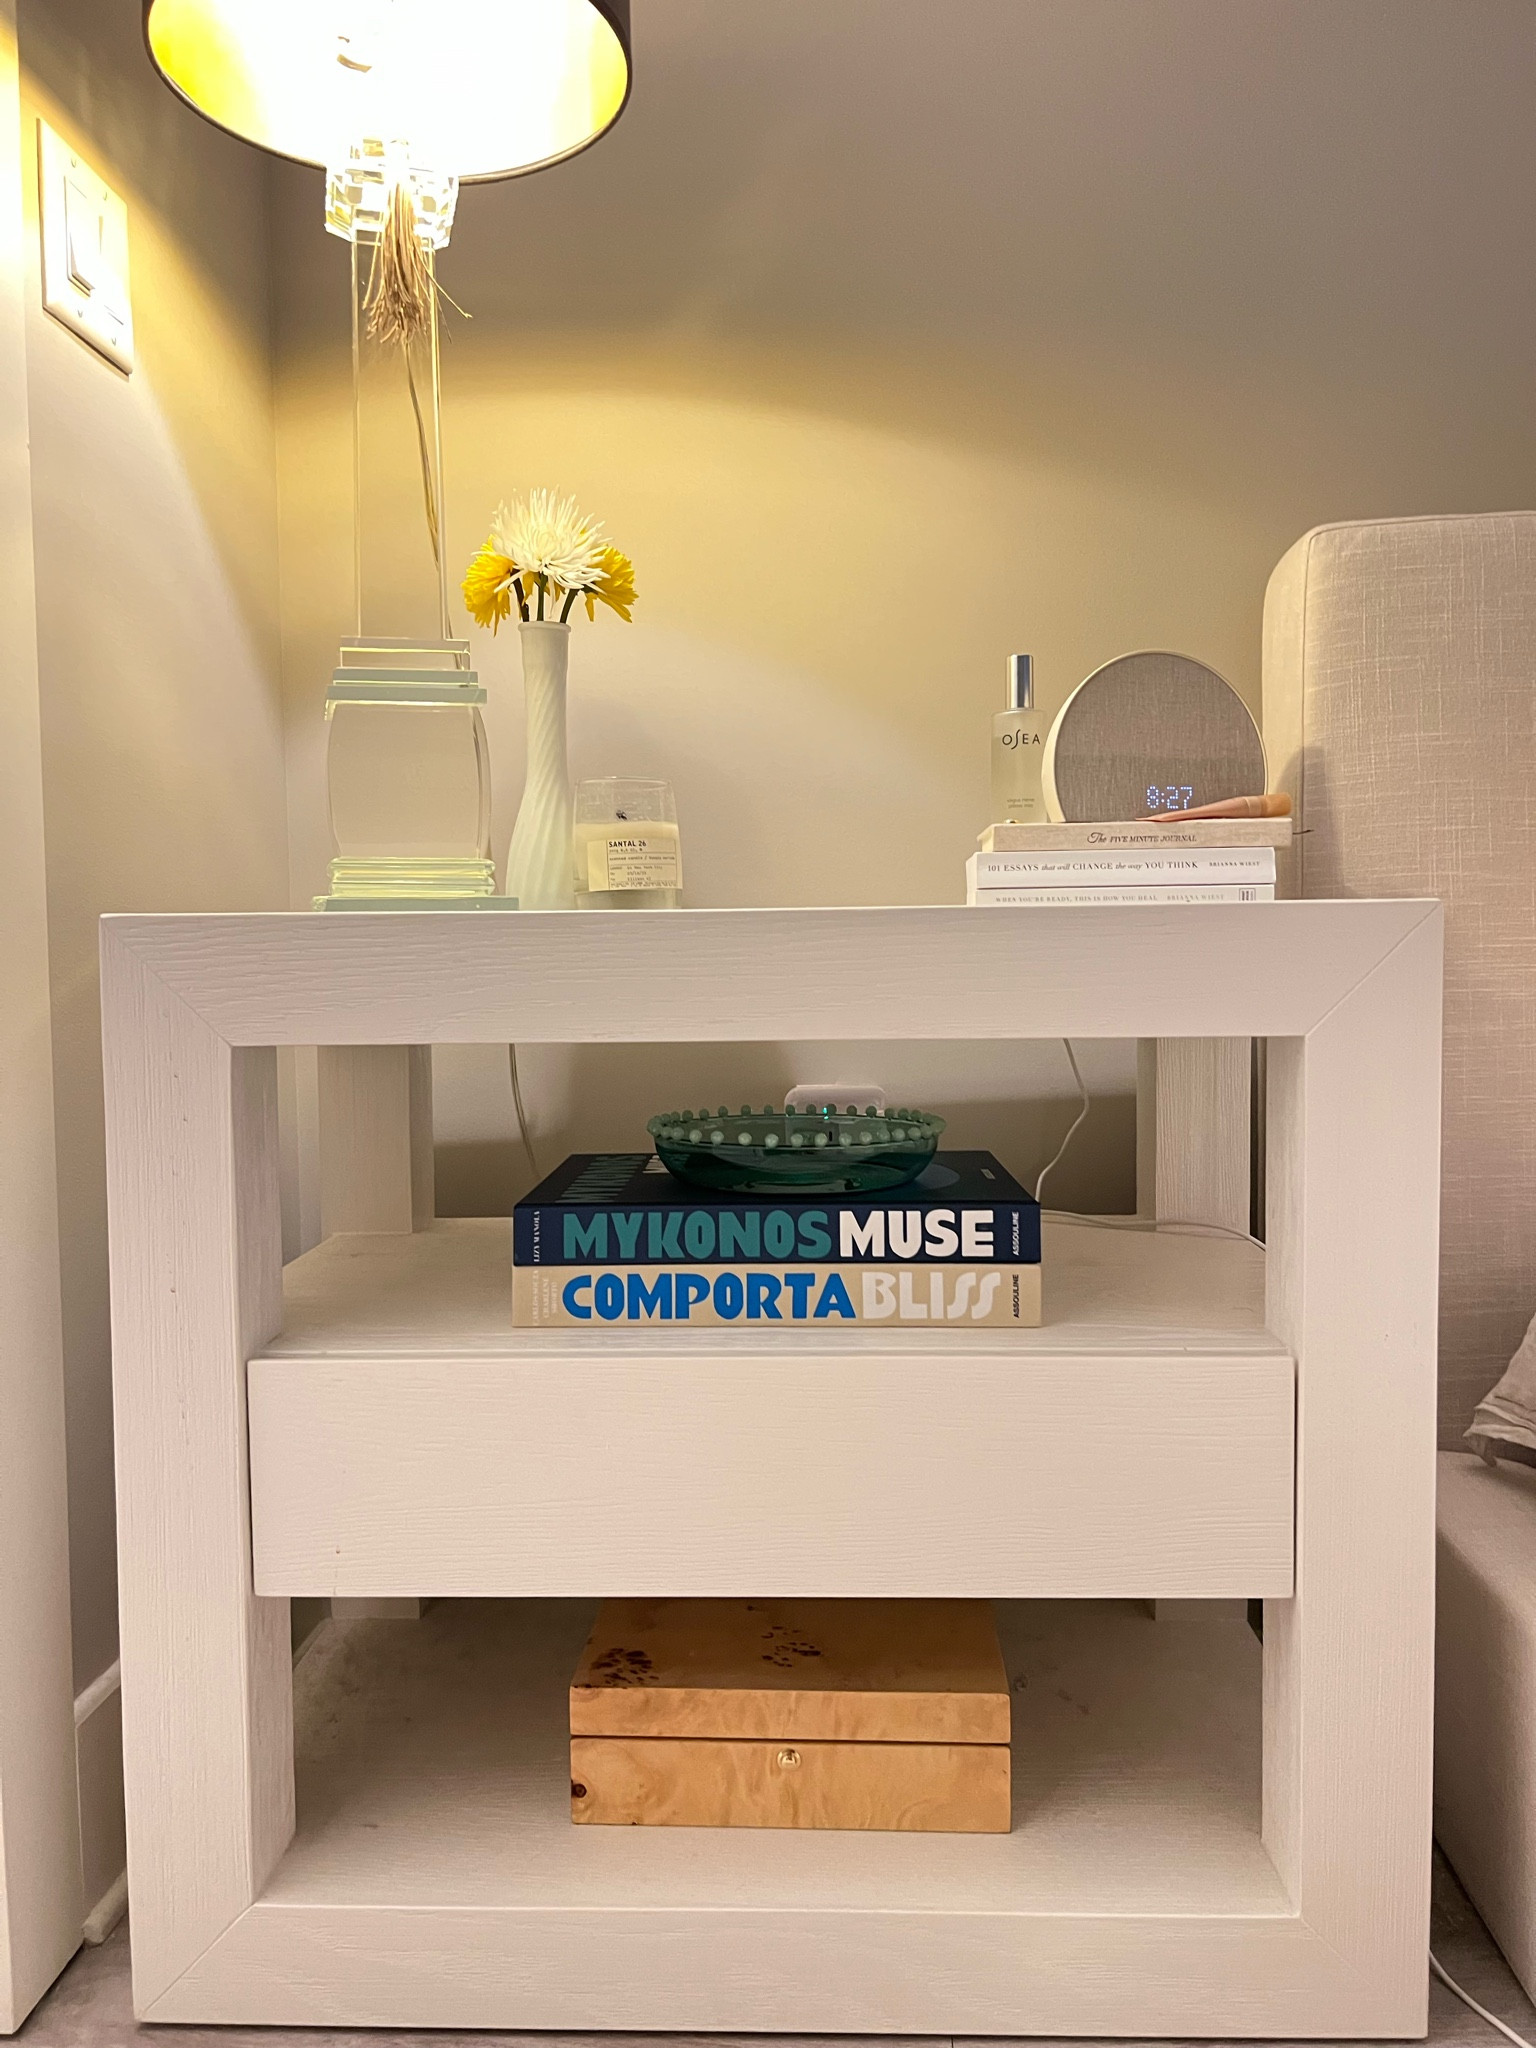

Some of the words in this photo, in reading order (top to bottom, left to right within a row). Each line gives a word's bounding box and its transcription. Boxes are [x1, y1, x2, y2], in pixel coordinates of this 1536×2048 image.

[1002, 729, 1040, 750] OSEA
[1146, 785, 1193, 810] 8:27
[608, 840, 636, 848] SANTAL
[1087, 831, 1107, 844] The
[1110, 835, 1129, 843] FIVE
[1129, 835, 1159, 843] MINUTE
[987, 864, 1000, 872] 101
[1003, 864, 1039, 872] ESSAYS
[1041, 863, 1055, 871] that
[1057, 863, 1070, 871] will
[1072, 862, 1113, 871] CHANGE
[1115, 862, 1126, 870] the
[1128, 863, 1143, 871] way
[1145, 861, 1164, 869] YOU
[1167, 861, 1198, 869] THINK
[562, 1209, 832, 1259] MYKONOS
[839, 1208, 995, 1258] MUSE
[1011, 1211, 1020, 1256] ASSOULINE
[561, 1272, 856, 1320] COMPORTA
[861, 1271, 1001, 1320] BLISS
[1012, 1273, 1020, 1319] ASSOULINE
